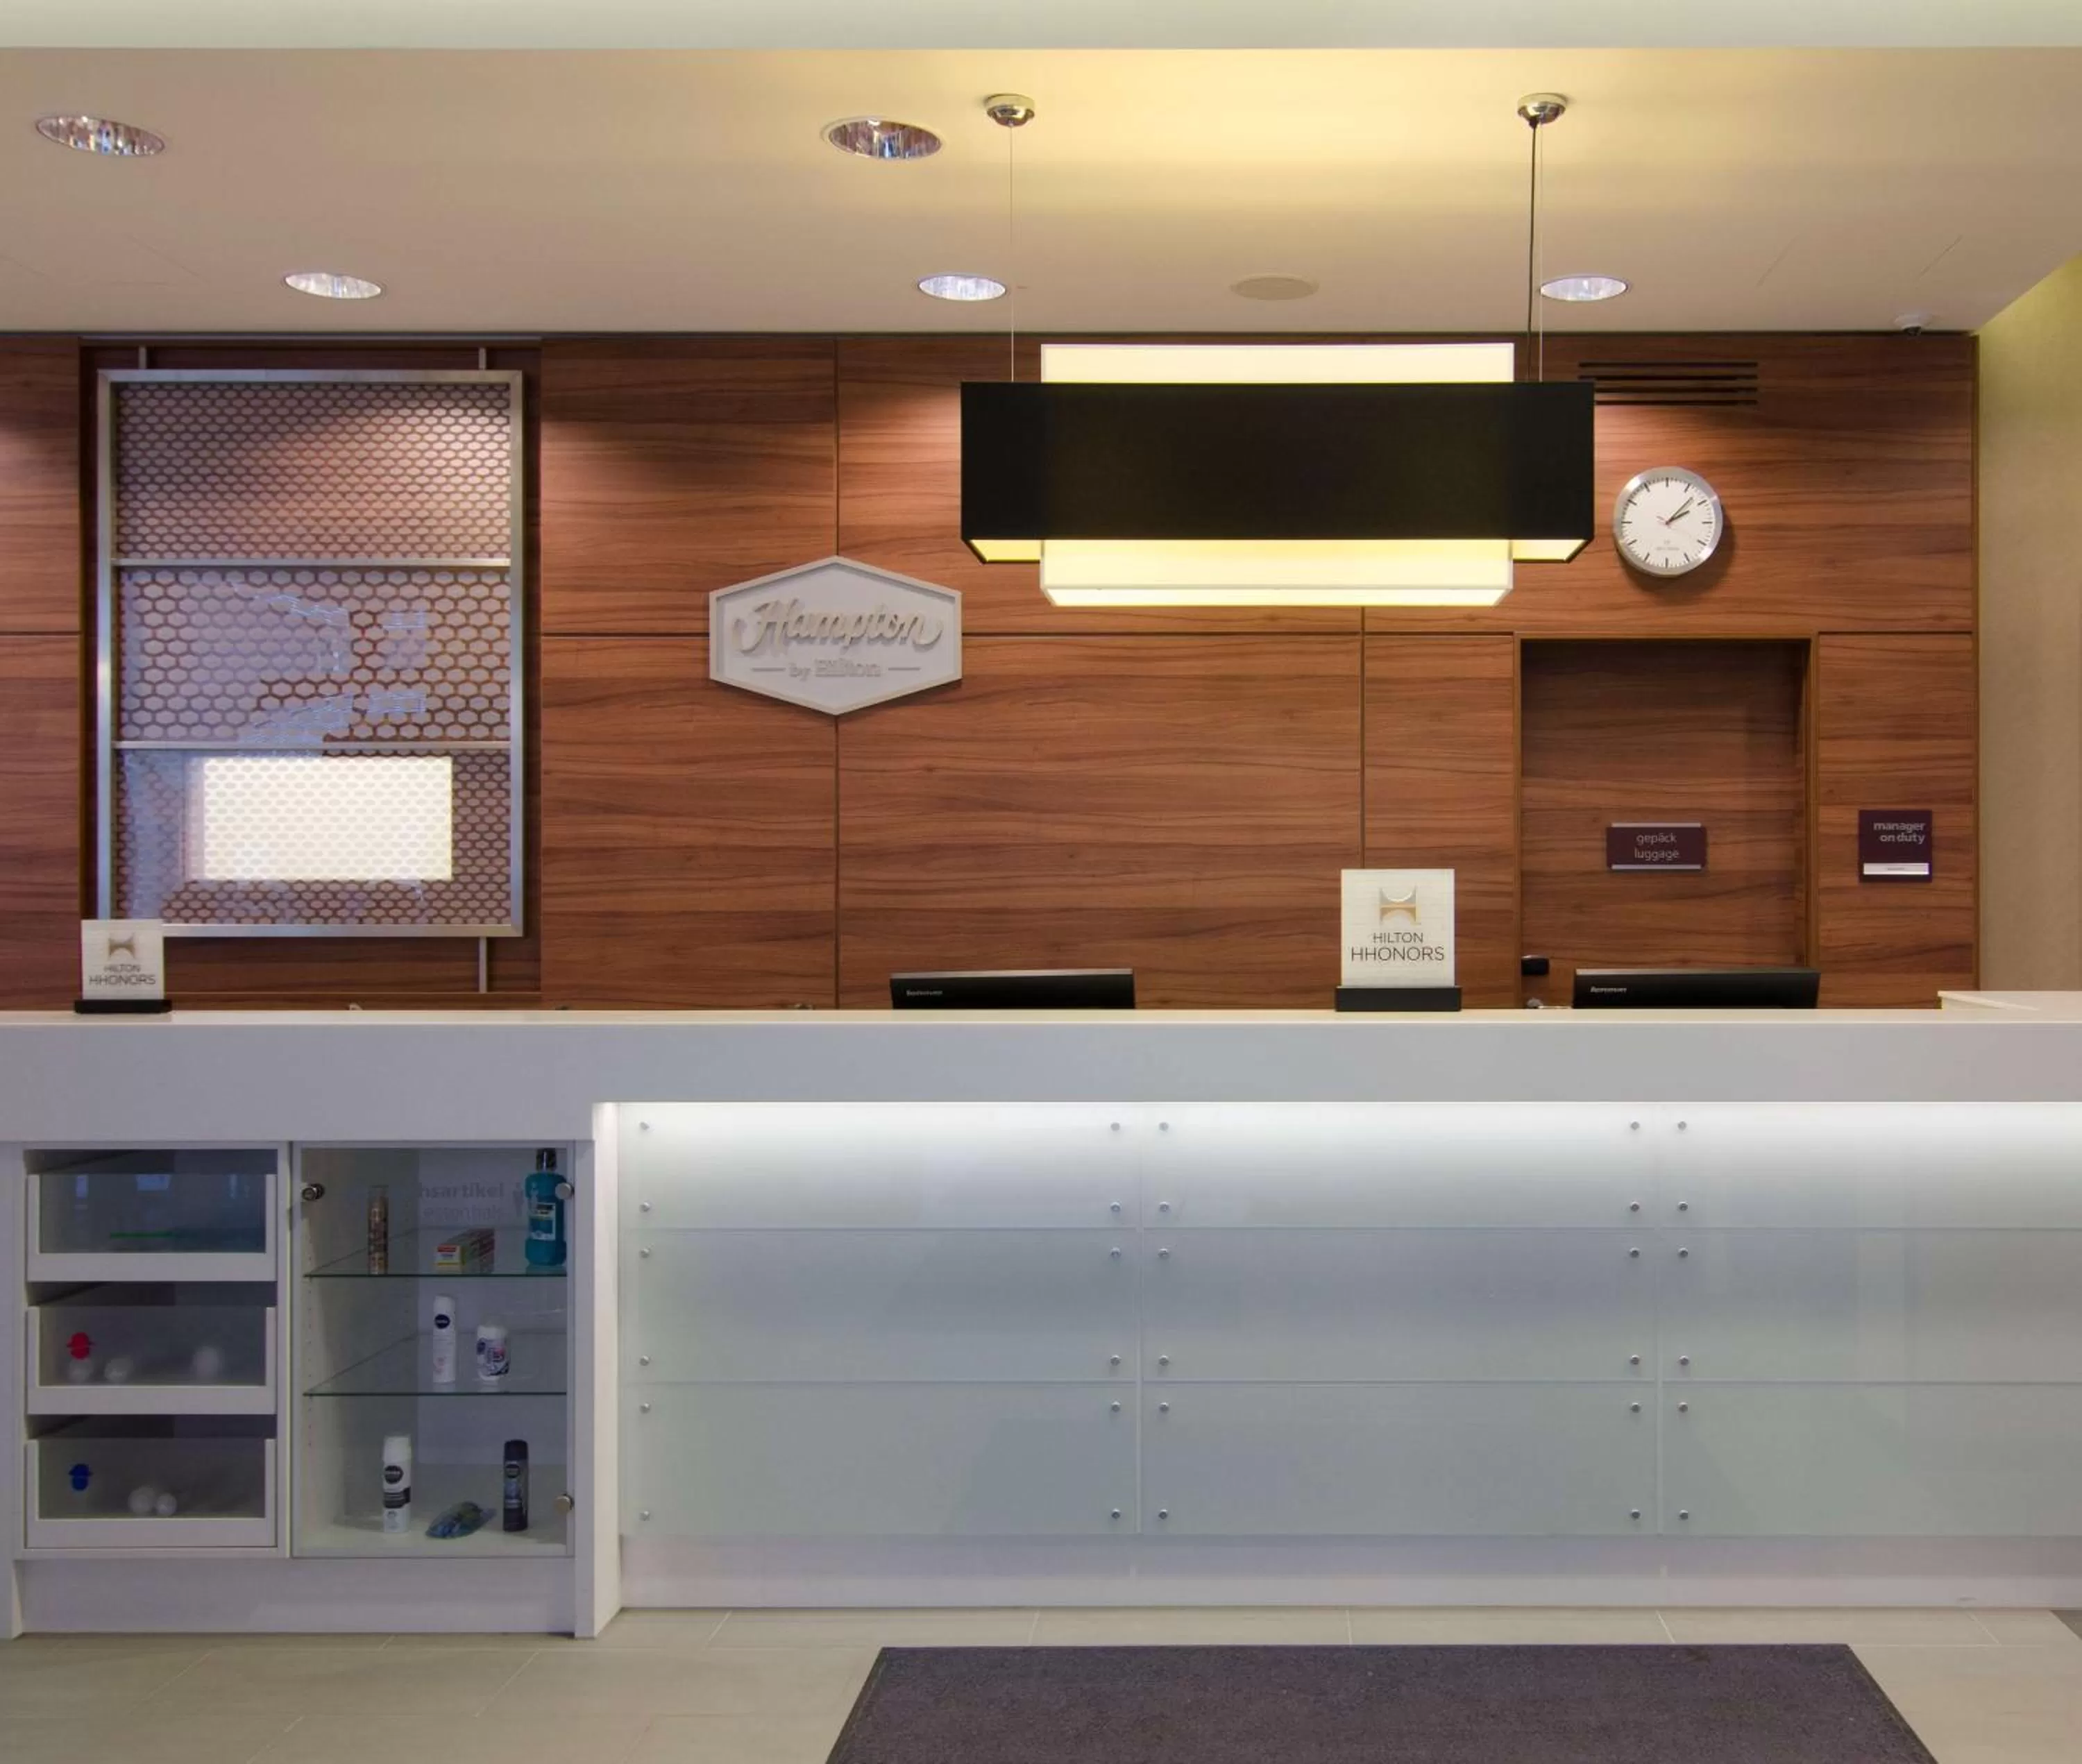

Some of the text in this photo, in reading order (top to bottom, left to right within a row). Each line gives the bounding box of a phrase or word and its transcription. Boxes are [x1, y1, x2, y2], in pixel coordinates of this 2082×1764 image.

[731, 597, 945, 654] Hampton
[788, 662, 811, 681] by
[1873, 822, 1925, 833] manager
[1636, 832, 1677, 845] gepäck
[1879, 832, 1925, 845] on duty
[1634, 847, 1680, 861] luggage
[1373, 932, 1423, 944] HILTON
[1351, 946, 1445, 962] HHONORS
[89, 974, 156, 985] HHONORS
